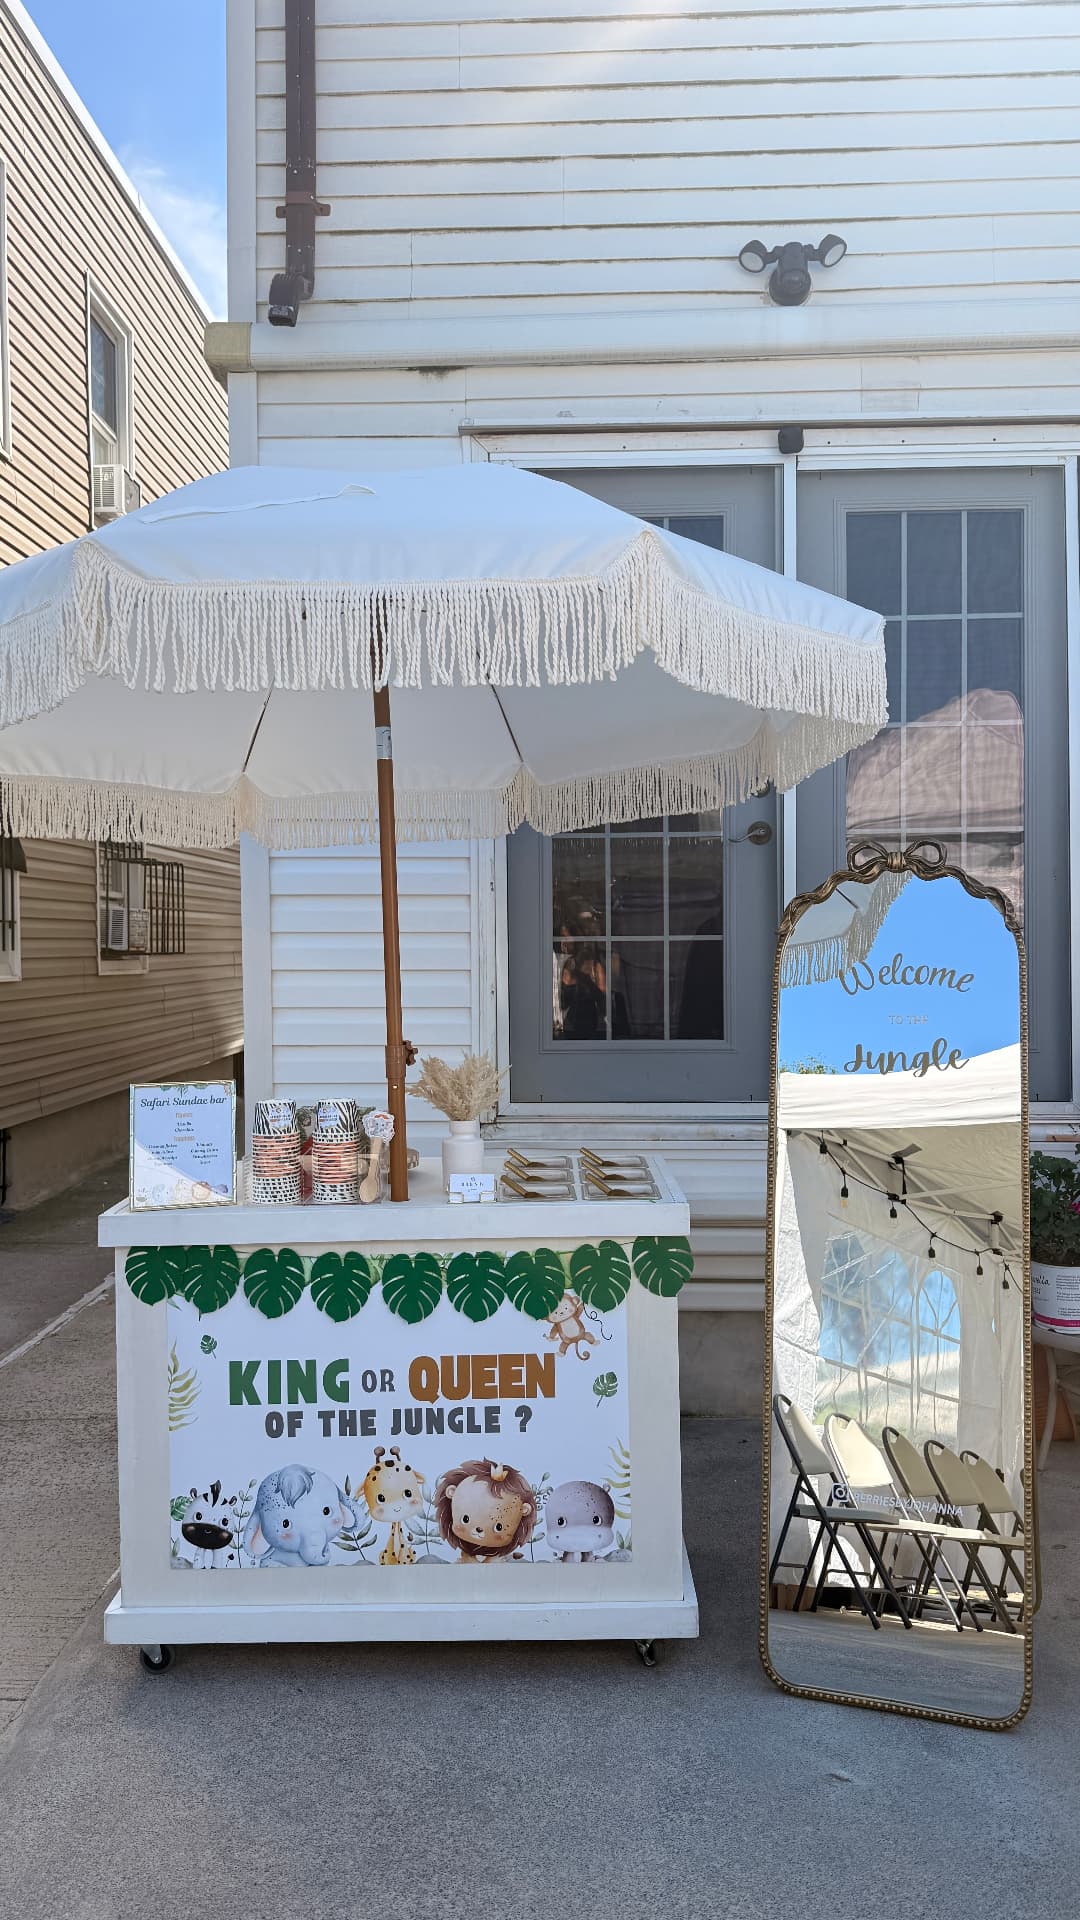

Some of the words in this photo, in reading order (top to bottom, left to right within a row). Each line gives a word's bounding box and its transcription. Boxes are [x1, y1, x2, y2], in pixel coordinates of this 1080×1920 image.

[838, 953, 975, 995] Welcome
[888, 1015, 904, 1025] TO
[906, 1015, 929, 1025] THE
[844, 1038, 970, 1078] Jungle
[140, 1098, 170, 1110] Safari
[172, 1096, 208, 1105] Sundae
[209, 1095, 226, 1104] bar
[228, 1358, 350, 1406] KING
[361, 1368, 396, 1393] OR
[408, 1352, 556, 1404] QUEEN
[264, 1410, 304, 1439] OF
[317, 1408, 378, 1437] THE
[390, 1405, 501, 1436] JUNGLE
[514, 1404, 533, 1433] ?
